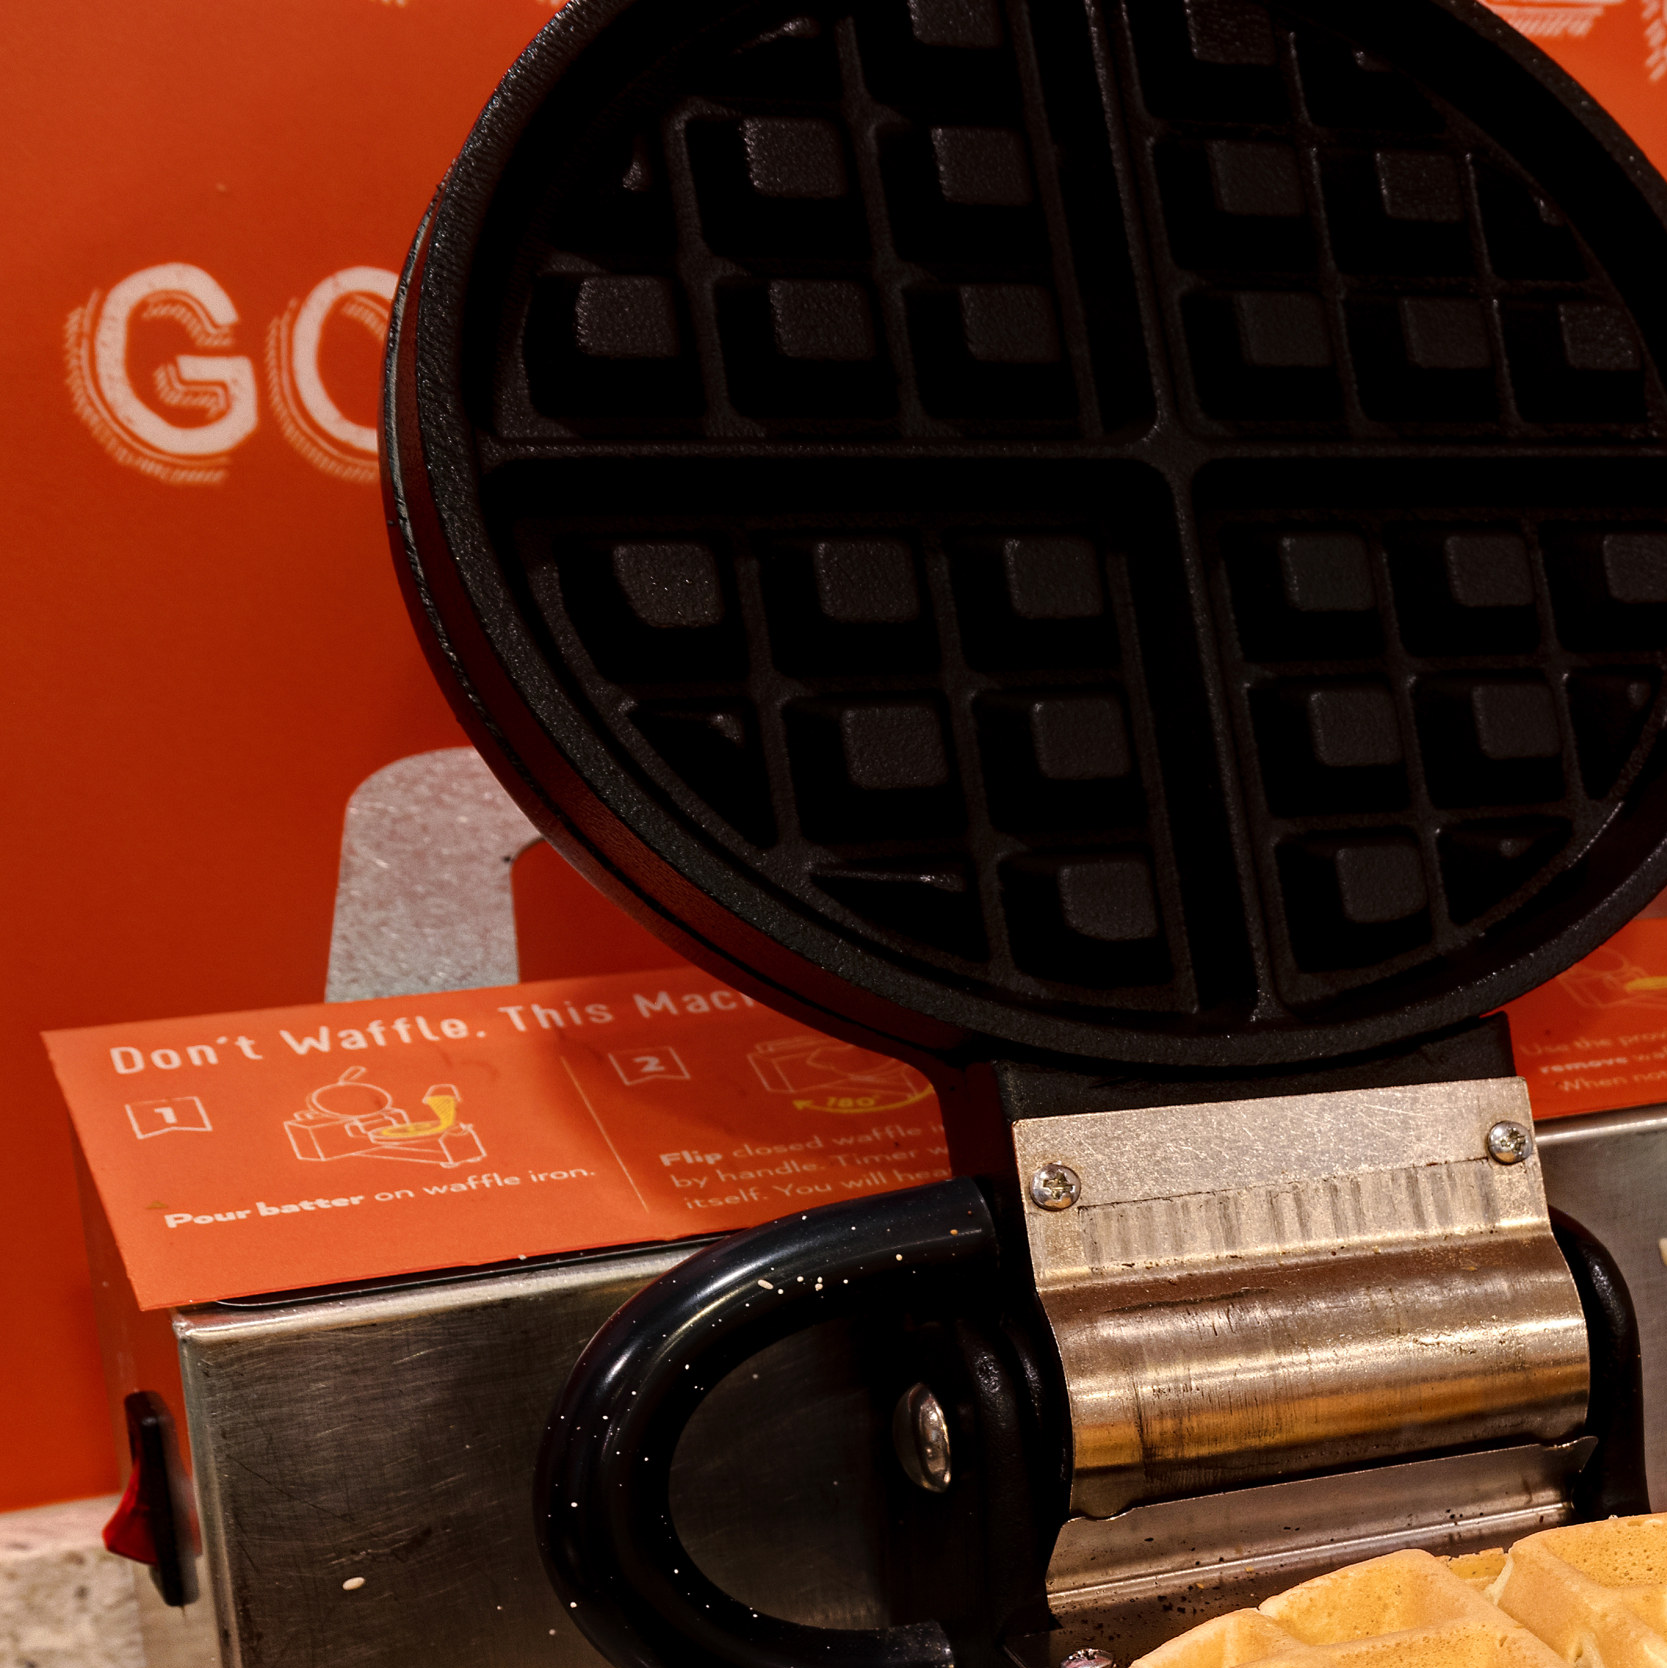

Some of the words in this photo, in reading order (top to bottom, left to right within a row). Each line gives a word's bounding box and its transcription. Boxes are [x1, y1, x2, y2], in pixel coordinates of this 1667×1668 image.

[109, 1035, 263, 1074] Don't
[280, 1016, 486, 1055] Waffle.
[497, 1001, 615, 1032] This
[634, 1055, 665, 1073] 2
[152, 1107, 177, 1125] 1
[659, 1150, 723, 1167] Flip
[732, 1136, 823, 1158] closed
[832, 1124, 921, 1146] waffle
[670, 1174, 708, 1189] by
[717, 1160, 825, 1182] handle.
[833, 1148, 918, 1168] Timer
[771, 1182, 832, 1197] You
[841, 1170, 887, 1189] will
[893, 1166, 951, 1184] hea
[164, 1205, 251, 1229] Pour
[255, 1192, 365, 1216] batter
[374, 1185, 414, 1203] on
[423, 1172, 521, 1196] waffle
[530, 1165, 597, 1183] iron.
